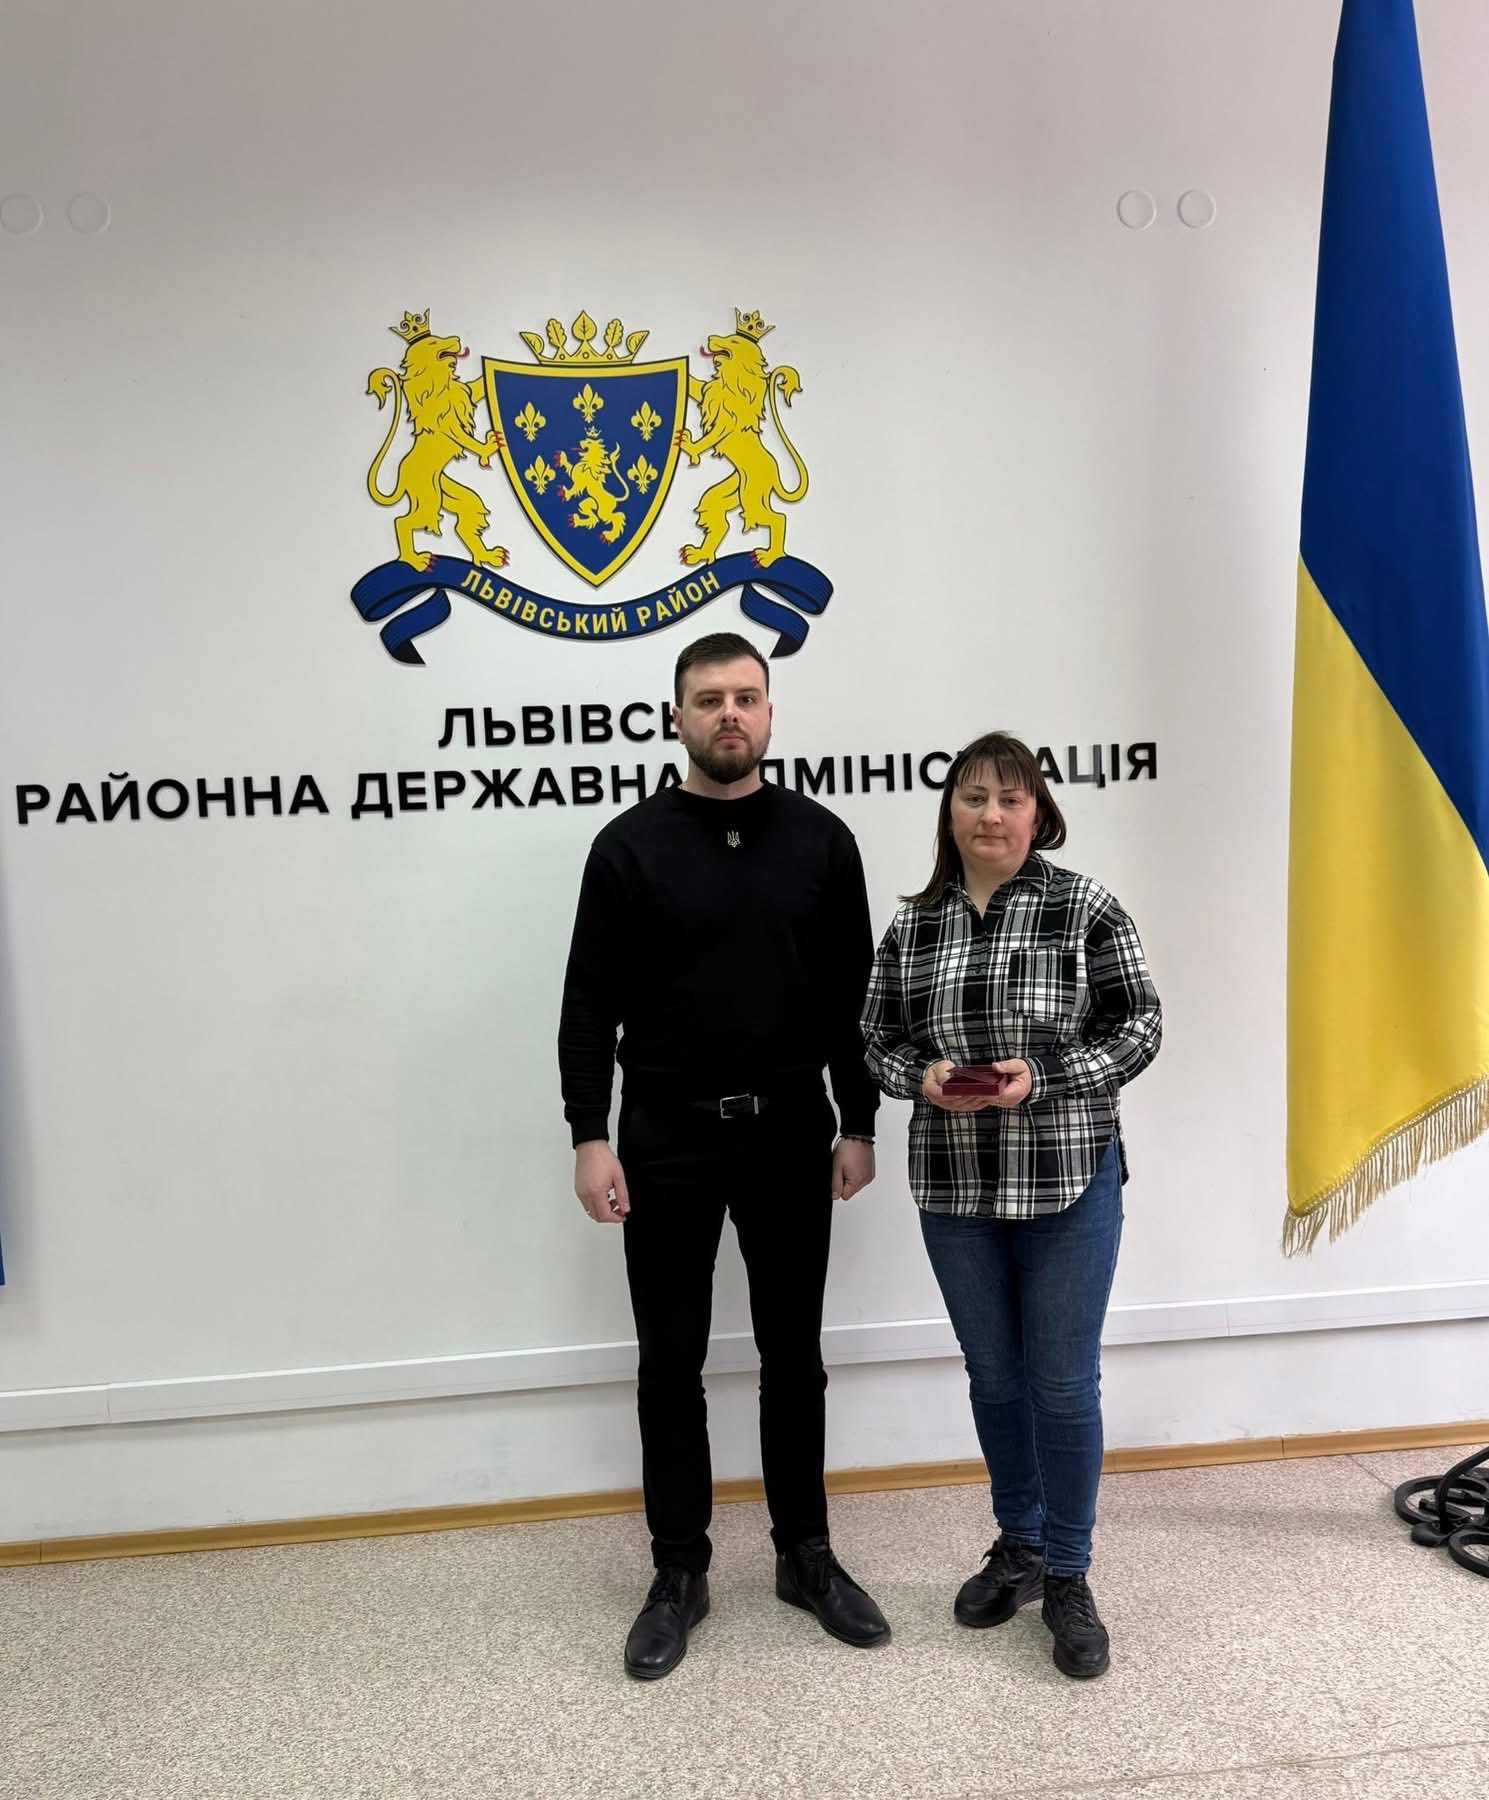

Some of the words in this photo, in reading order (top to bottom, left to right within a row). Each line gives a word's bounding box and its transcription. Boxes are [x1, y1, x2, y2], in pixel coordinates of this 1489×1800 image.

[461, 568, 629, 634] ЛЬВІВСЬКИЙ
[637, 571, 722, 628] РАЙОН
[438, 701, 679, 748] ЛЬВІВСЬ
[15, 771, 330, 825] РАЙОННА
[351, 762, 684, 820] ДЕРЖАВНА
[759, 742, 1158, 795] ДМІНІСАЦІЯ
